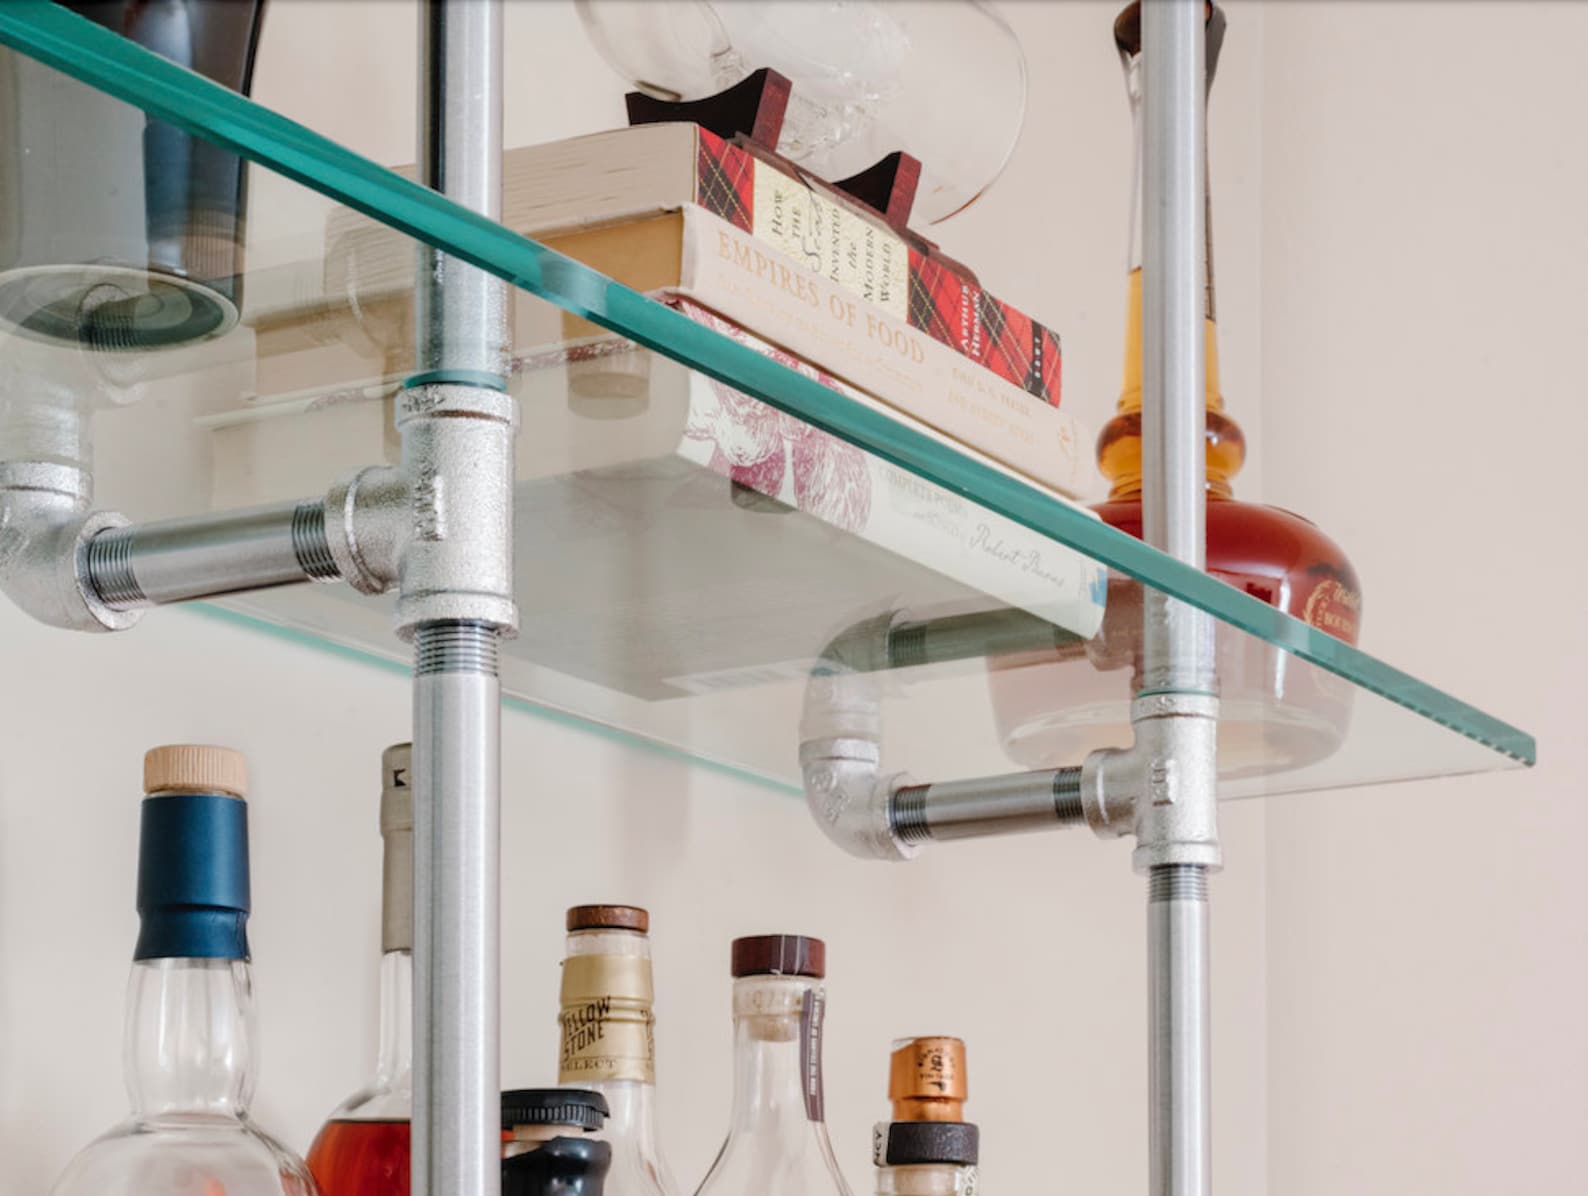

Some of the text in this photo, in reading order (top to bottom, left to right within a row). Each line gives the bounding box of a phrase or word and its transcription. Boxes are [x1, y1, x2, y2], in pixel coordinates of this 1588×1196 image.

[829, 207, 841, 283] INVENTED
[863, 225, 875, 302] MODERN
[880, 242, 892, 302] WORLD
[718, 229, 821, 309] EMPIRES
[828, 293, 858, 329] OF
[866, 312, 926, 366] FOOD
